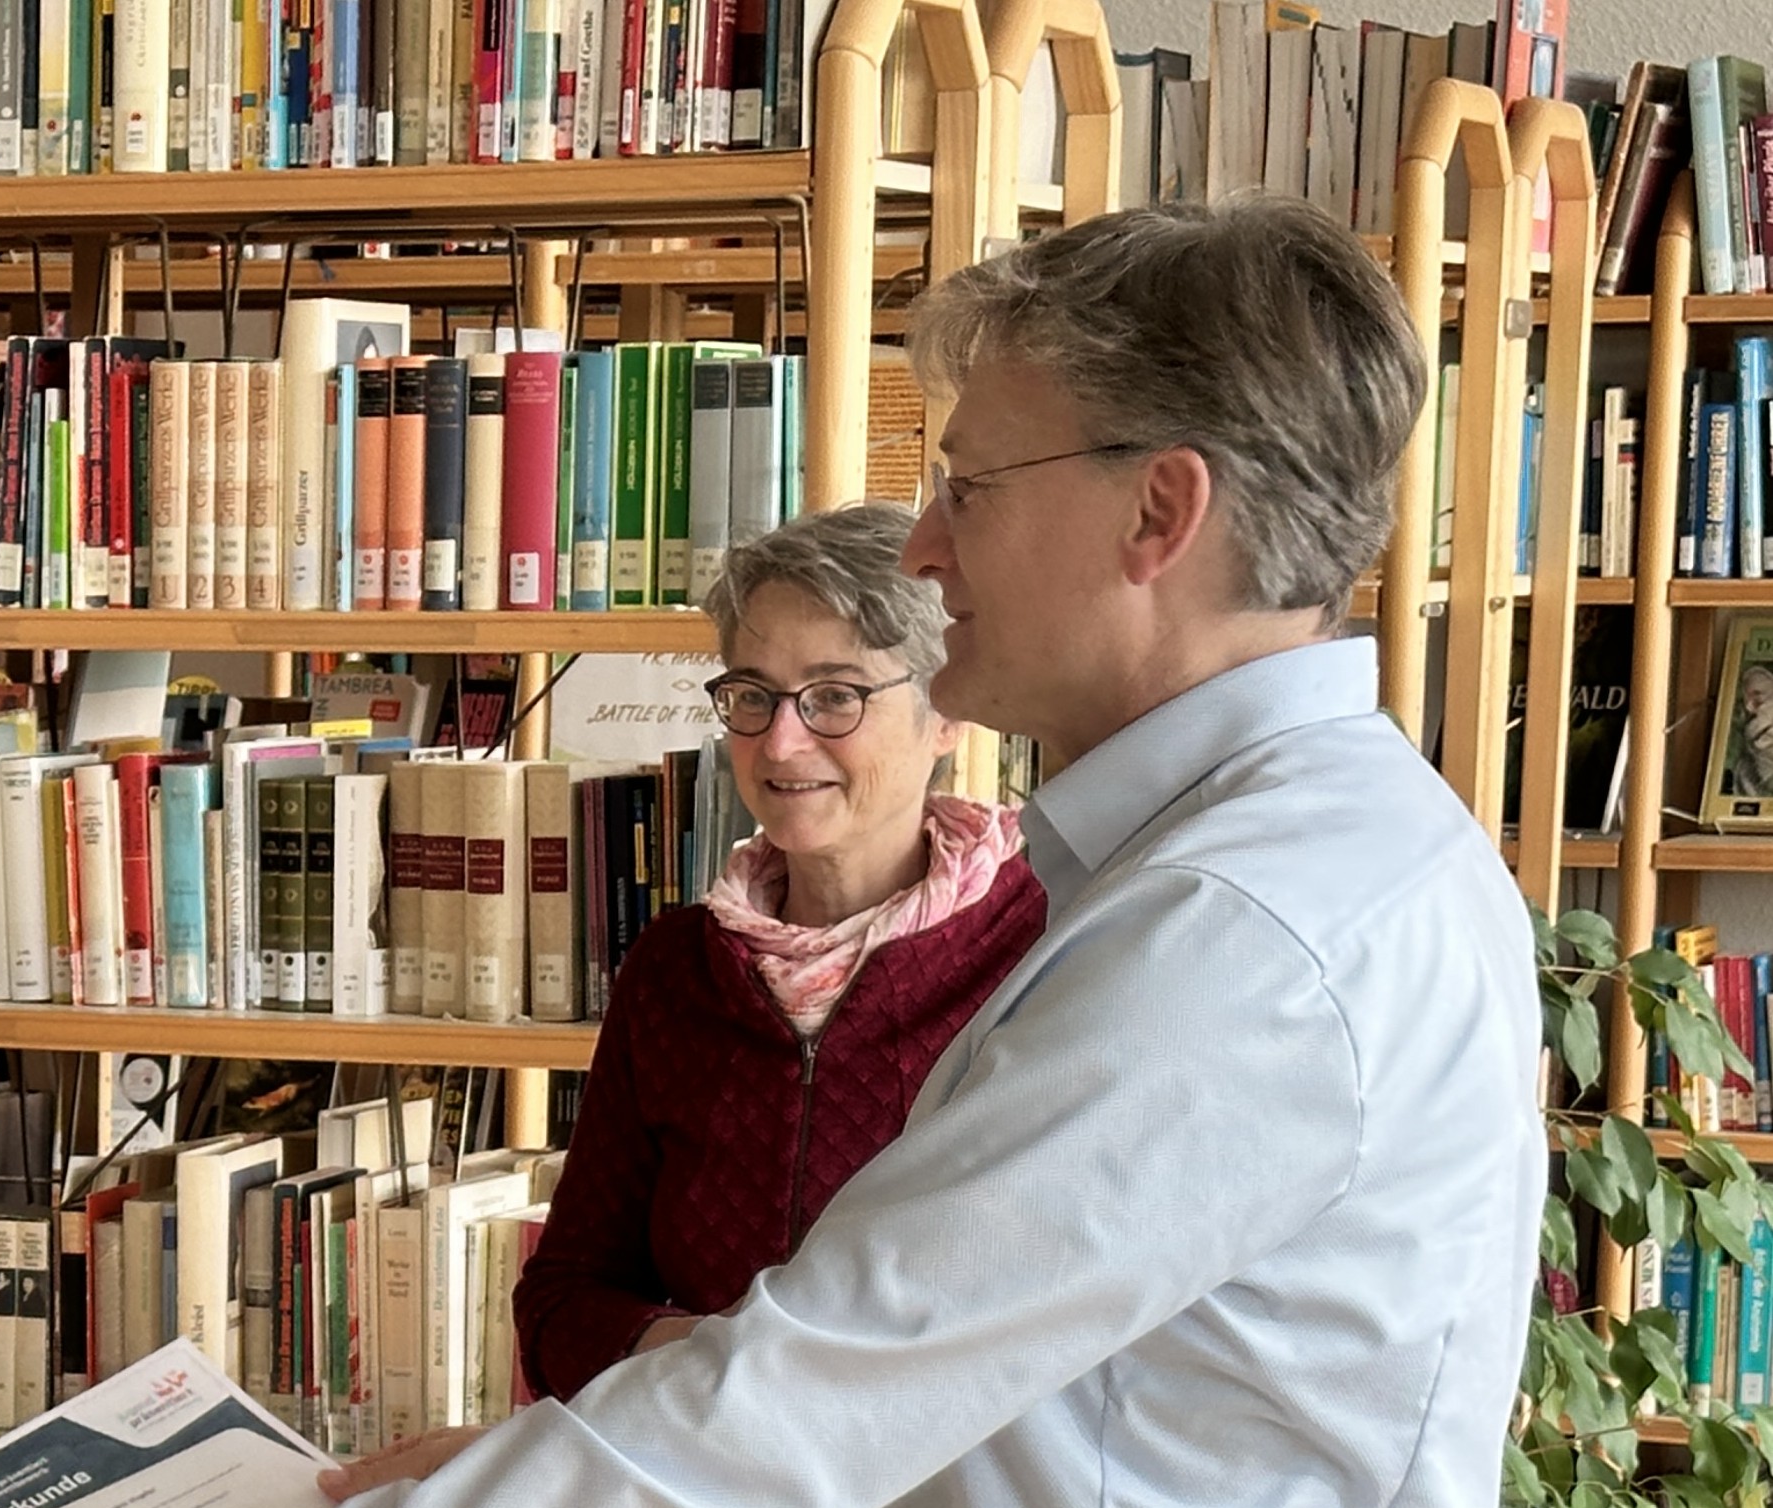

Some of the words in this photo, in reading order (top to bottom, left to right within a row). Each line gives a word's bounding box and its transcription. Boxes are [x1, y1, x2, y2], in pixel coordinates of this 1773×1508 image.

[294, 470, 310, 547] Grillparzer
[320, 676, 393, 696] TAMBREA
[657, 705, 681, 723] OF
[684, 704, 714, 723] THE
[1753, 1248, 1766, 1277] Atlas
[1749, 1300, 1764, 1353] Anatomie
